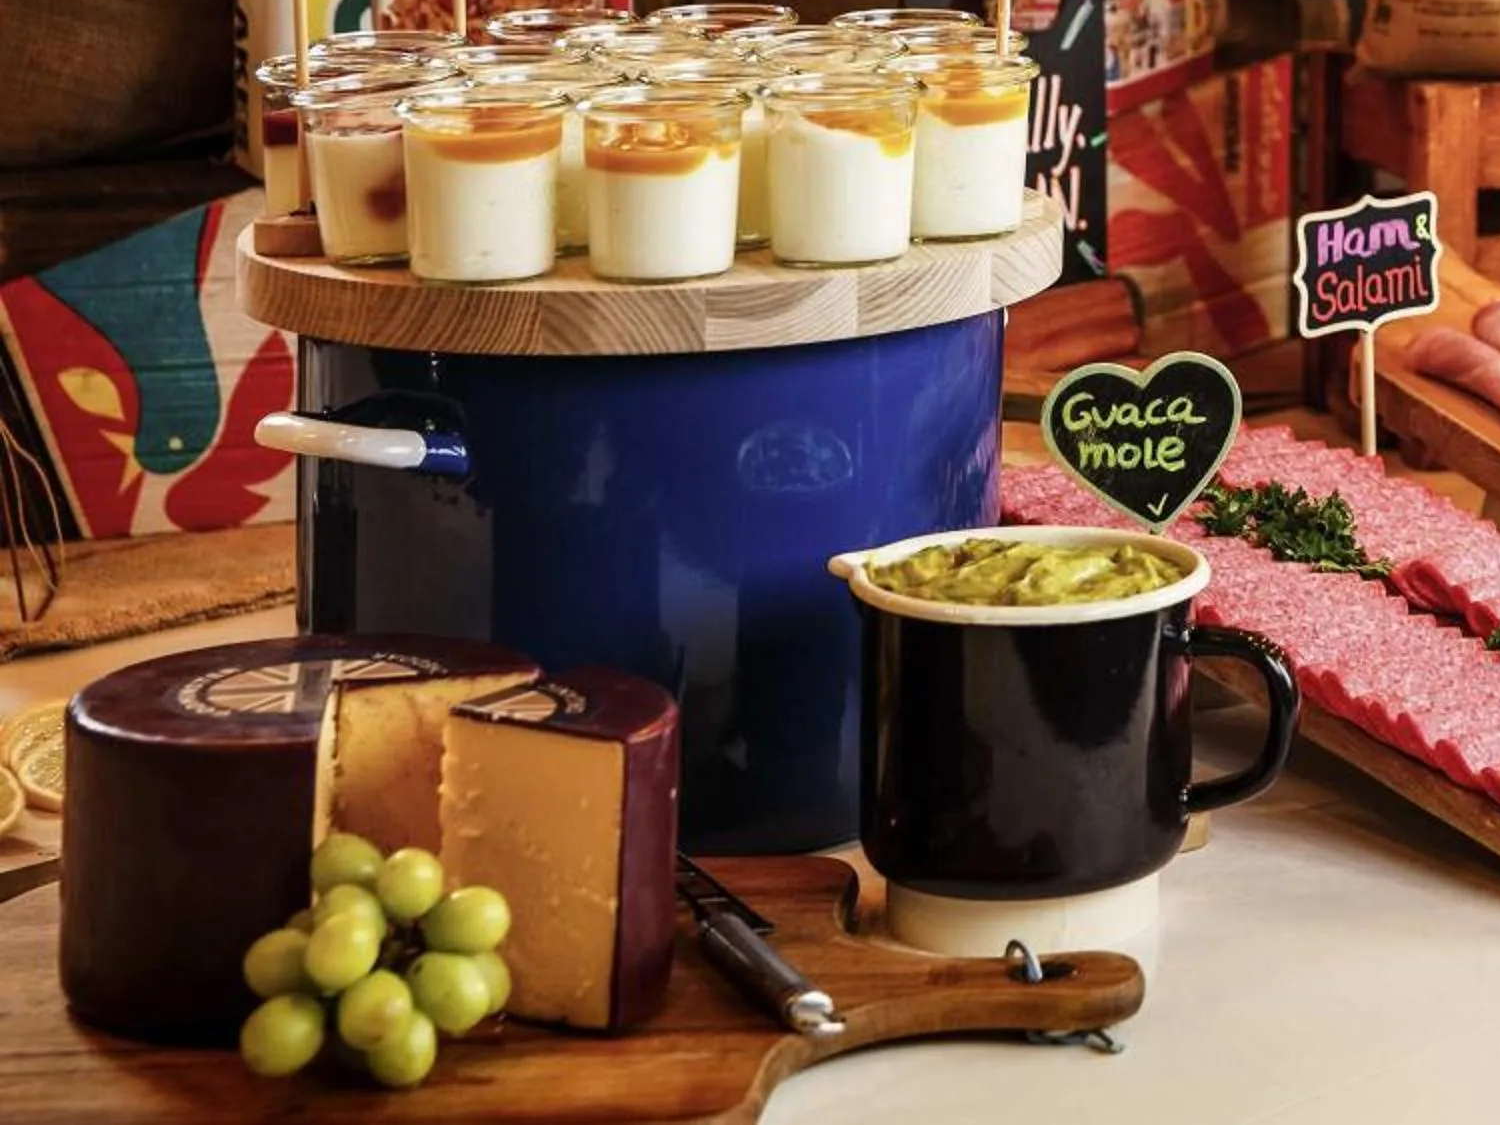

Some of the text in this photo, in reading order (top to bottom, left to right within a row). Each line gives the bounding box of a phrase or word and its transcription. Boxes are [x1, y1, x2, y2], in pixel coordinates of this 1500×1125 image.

[1316, 213, 1432, 268] Ham &
[1312, 255, 1429, 322] Salami
